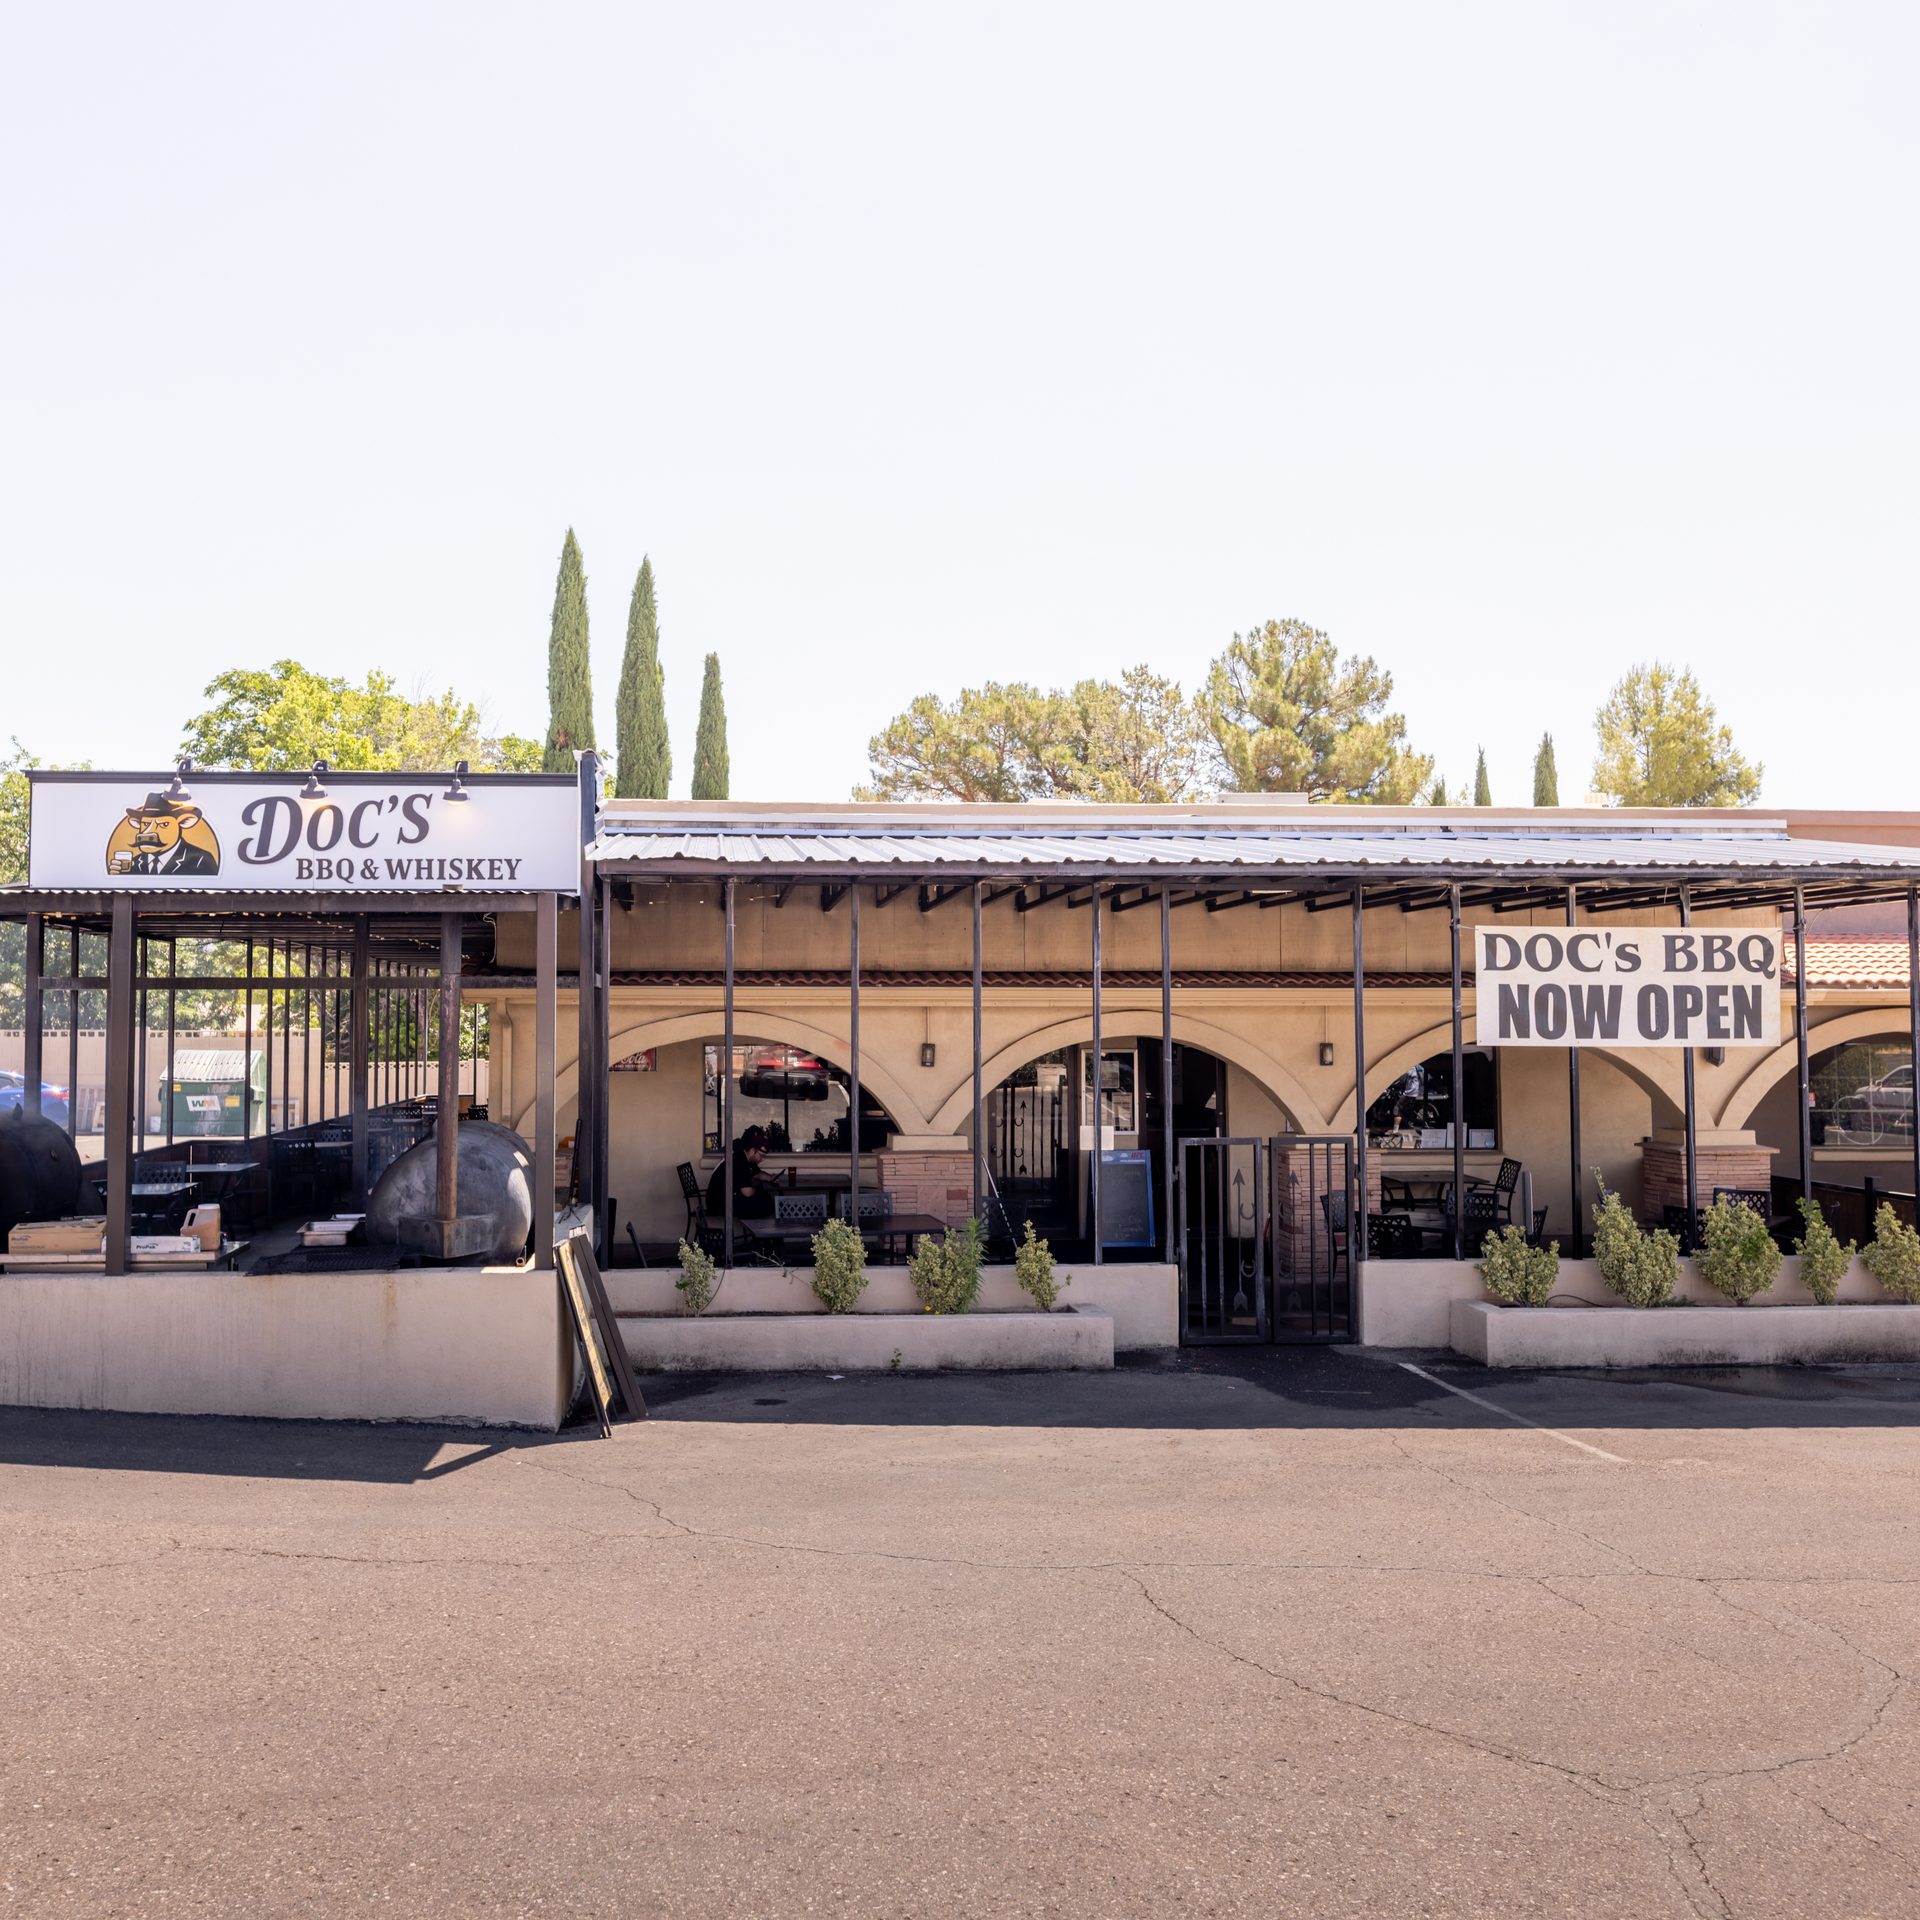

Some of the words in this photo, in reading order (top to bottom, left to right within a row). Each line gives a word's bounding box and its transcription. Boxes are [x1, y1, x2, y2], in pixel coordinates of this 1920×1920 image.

[295, 858, 354, 884] BBQ
[360, 858, 380, 880] &
[384, 858, 522, 880] WHISKEY
[1483, 932, 1642, 973] DOC's
[1662, 934, 1776, 979] BBQ
[1498, 983, 1623, 1040] NOW
[1637, 983, 1763, 1040] OPEN
